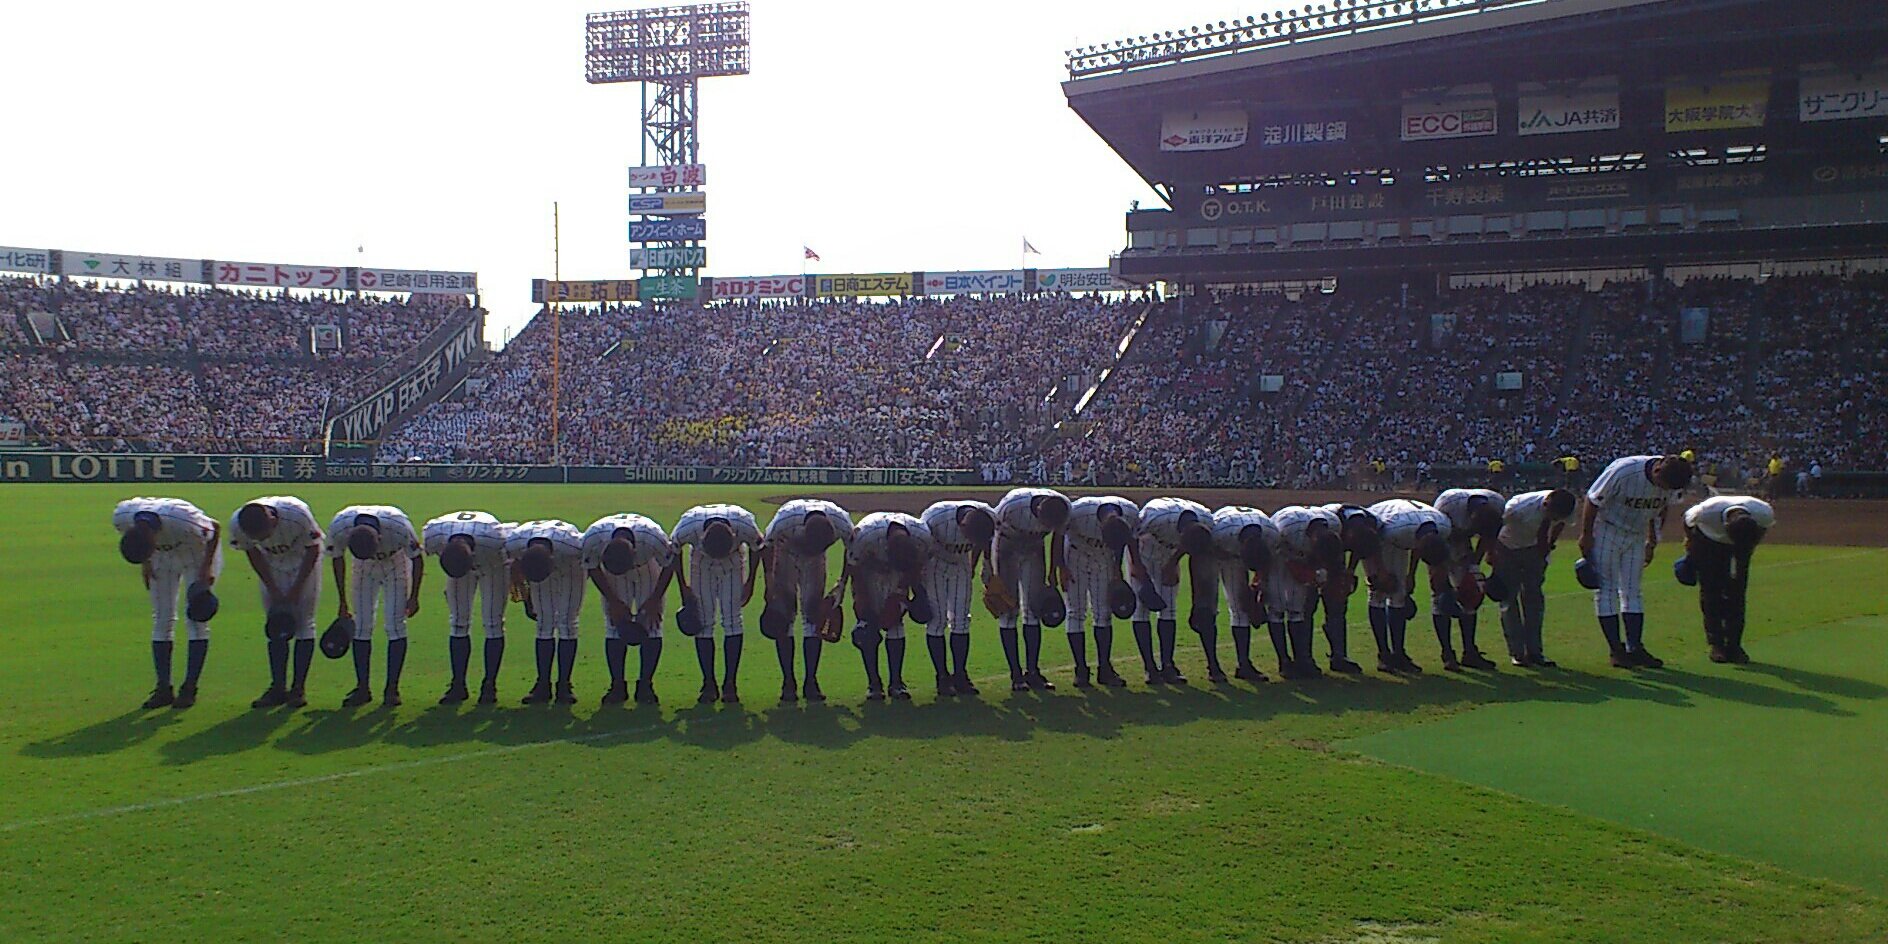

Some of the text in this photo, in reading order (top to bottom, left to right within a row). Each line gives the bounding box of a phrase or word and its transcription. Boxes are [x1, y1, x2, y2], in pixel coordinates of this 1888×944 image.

[1407, 114, 1459, 134] ECC
[1555, 109, 1616, 126] JA共済
[1264, 121, 1347, 145] 淀川製鋼
[660, 165, 702, 186] 白波
[630, 199, 663, 210] CSP
[1227, 203, 1270, 214] O.T.K.
[112, 258, 182, 278] 大林組
[219, 263, 341, 287] カニトップ
[380, 272, 476, 290] 尼崎信用金庫
[714, 278, 803, 296] オロナミンC
[834, 277, 909, 292] 日商エステム
[945, 275, 1023, 290] 日本ペイント
[1060, 272, 1112, 287] 明治安田
[51, 456, 175, 479] LOTTE
[198, 457, 317, 479] 大和証券
[327, 466, 368, 477] SEIKYO
[624, 467, 697, 481] SHIMANO
